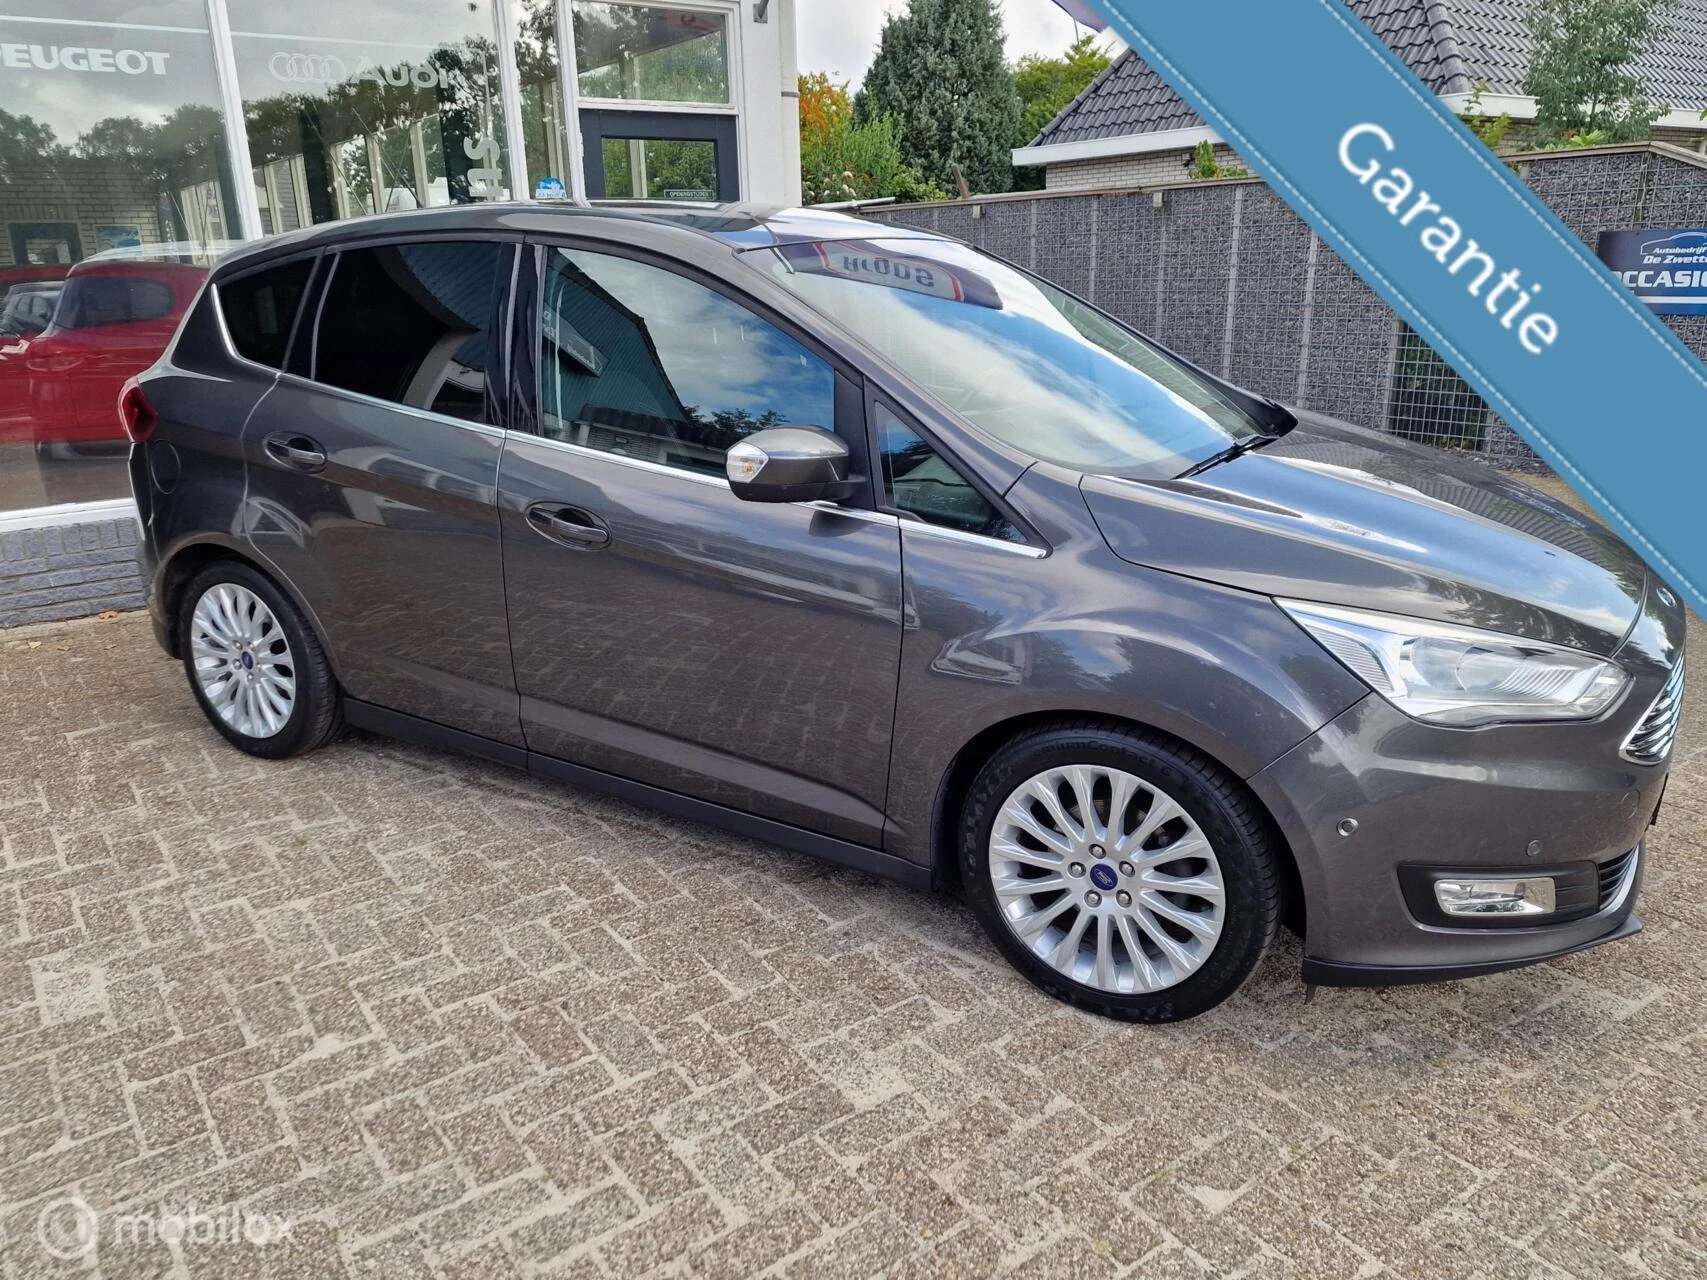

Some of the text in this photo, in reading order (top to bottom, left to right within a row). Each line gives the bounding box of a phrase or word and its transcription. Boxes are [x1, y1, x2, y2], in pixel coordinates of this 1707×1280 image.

[0, 43, 170, 75] EUGEOT
[350, 56, 449, 88] Audi
[1643, 255, 1661, 264] De
